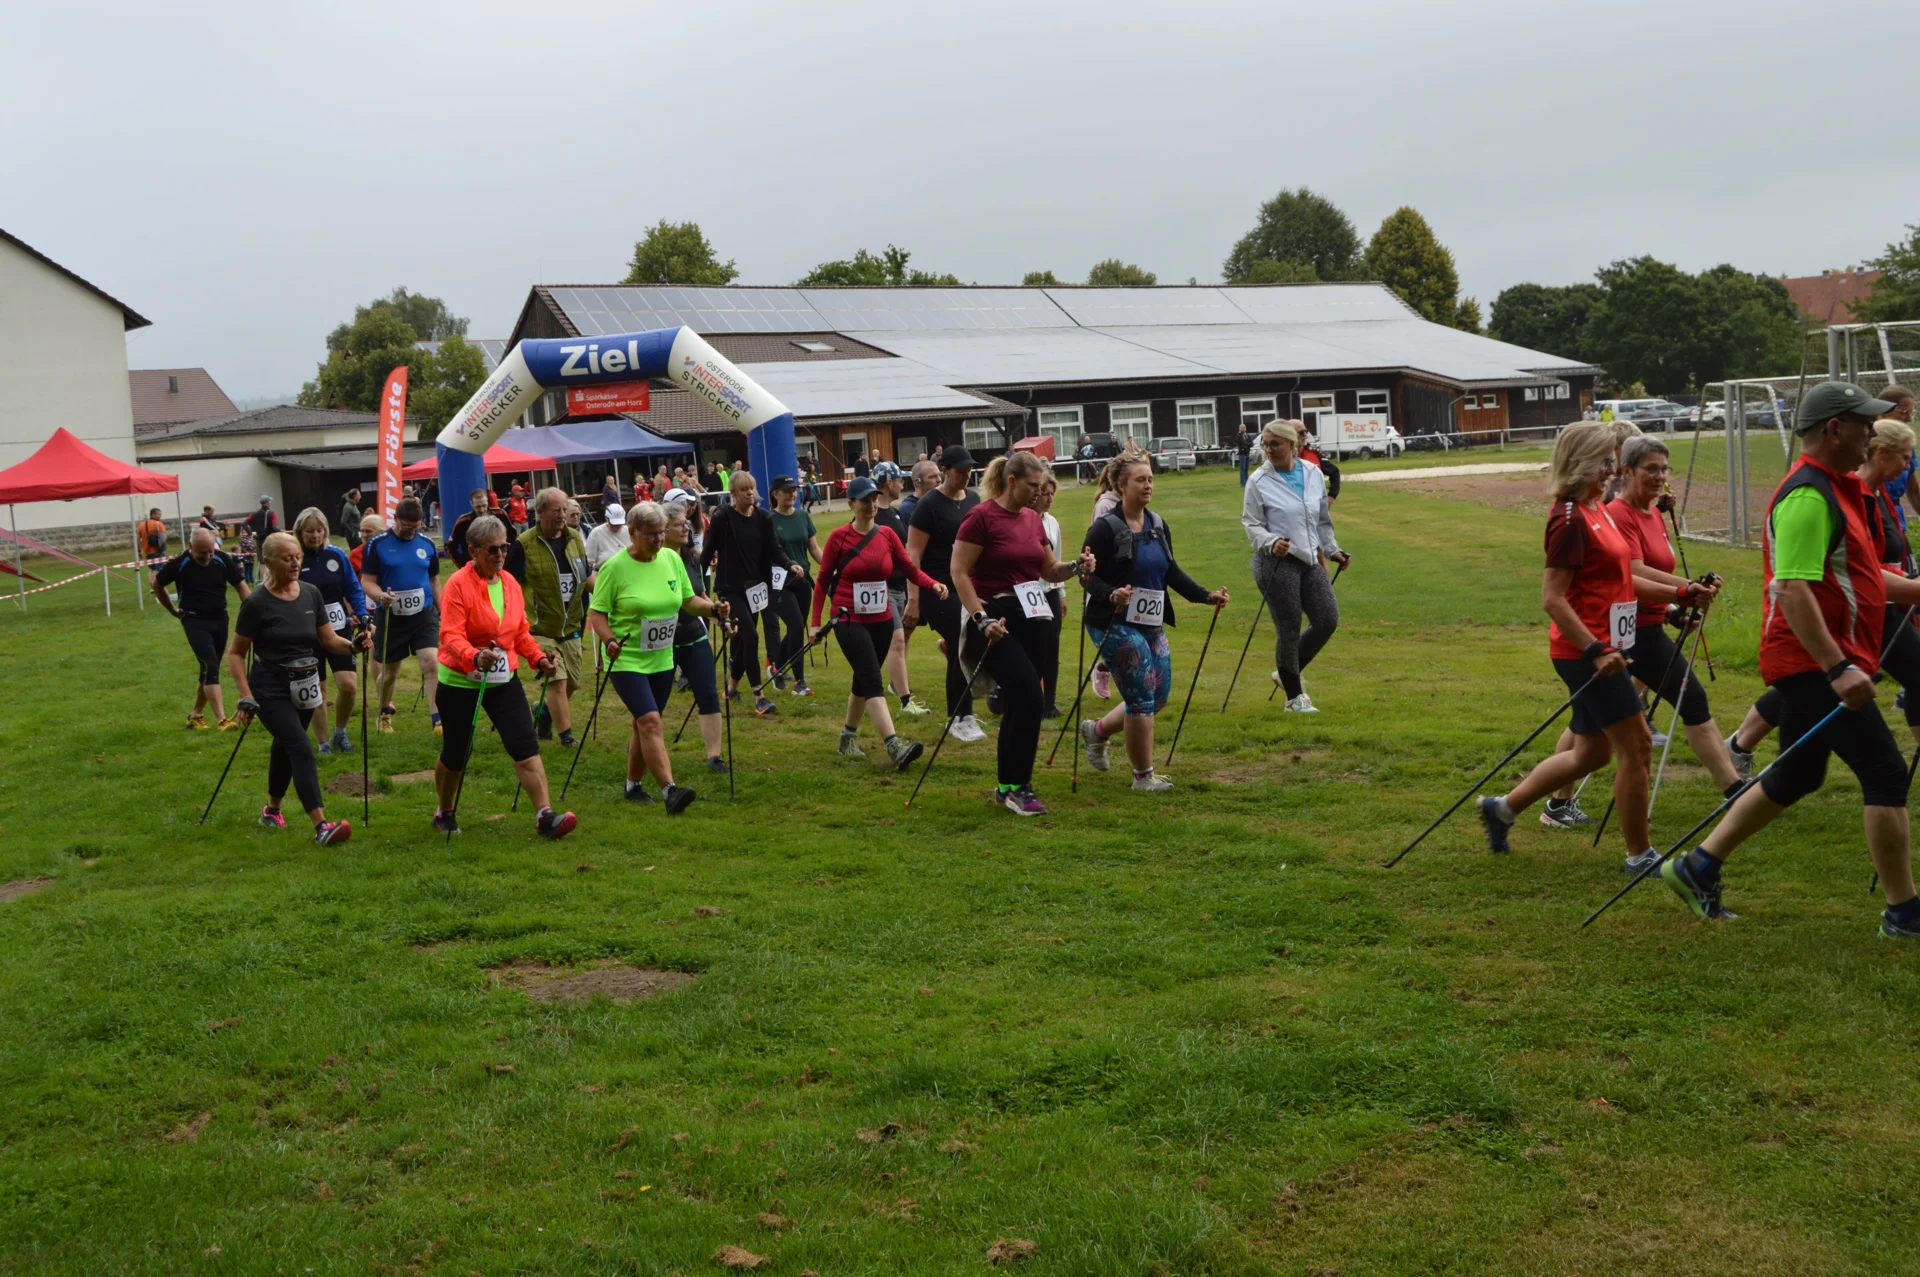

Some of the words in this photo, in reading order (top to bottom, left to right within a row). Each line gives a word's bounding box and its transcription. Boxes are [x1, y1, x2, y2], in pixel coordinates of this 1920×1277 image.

[559, 340, 641, 377] Ziel
[706, 361, 746, 394] OSTERODE
[464, 378, 497, 415] OSTERODE
[586, 393, 618, 402] Sparkasse
[681, 370, 741, 422] STRICKER
[692, 364, 753, 414] INTERSPORT
[464, 372, 515, 428] INTERSPORT
[586, 401, 615, 409] Osterode
[468, 385, 523, 441] STRICKER
[385, 381, 403, 466] Förste
[385, 470, 400, 529] MTV
[561, 581, 575, 594] 32
[752, 589, 768, 604] 012
[396, 596, 420, 609] 189
[860, 590, 886, 605] 017
[1026, 591, 1048, 606] 01
[329, 609, 343, 623] 90
[1137, 598, 1162, 616] 020
[648, 624, 675, 642] 085
[1618, 614, 1637, 637] 09
[299, 684, 321, 702] 03
